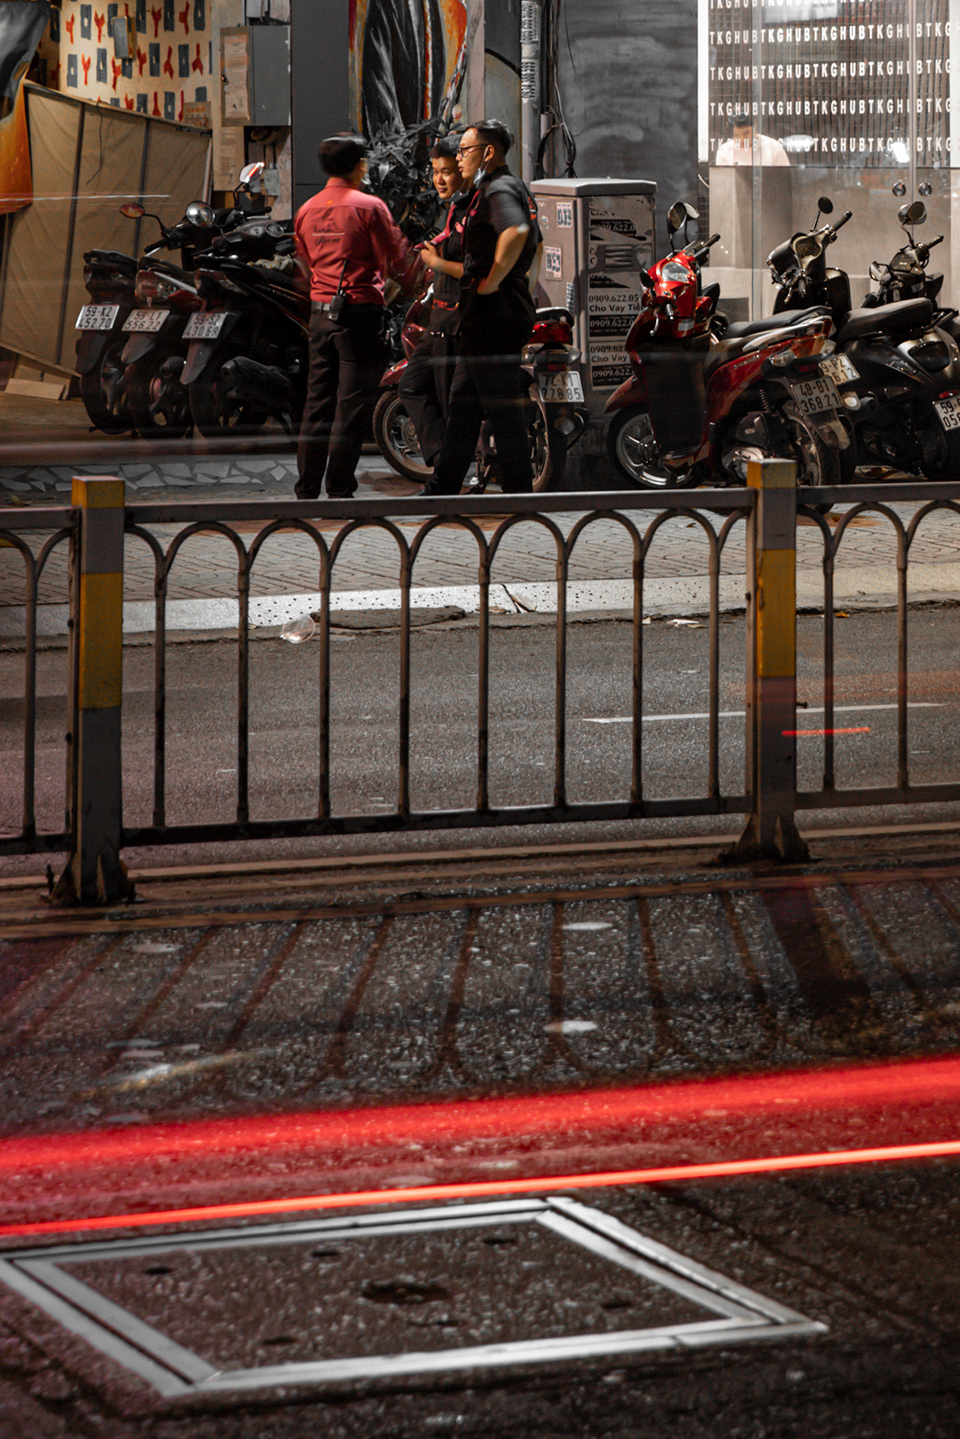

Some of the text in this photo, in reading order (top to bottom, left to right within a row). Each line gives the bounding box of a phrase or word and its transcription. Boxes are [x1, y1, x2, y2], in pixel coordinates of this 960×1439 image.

[589, 304, 607, 312] Cho
[609, 304, 625, 313] Vay
[591, 353, 628, 363] Cho Vay
